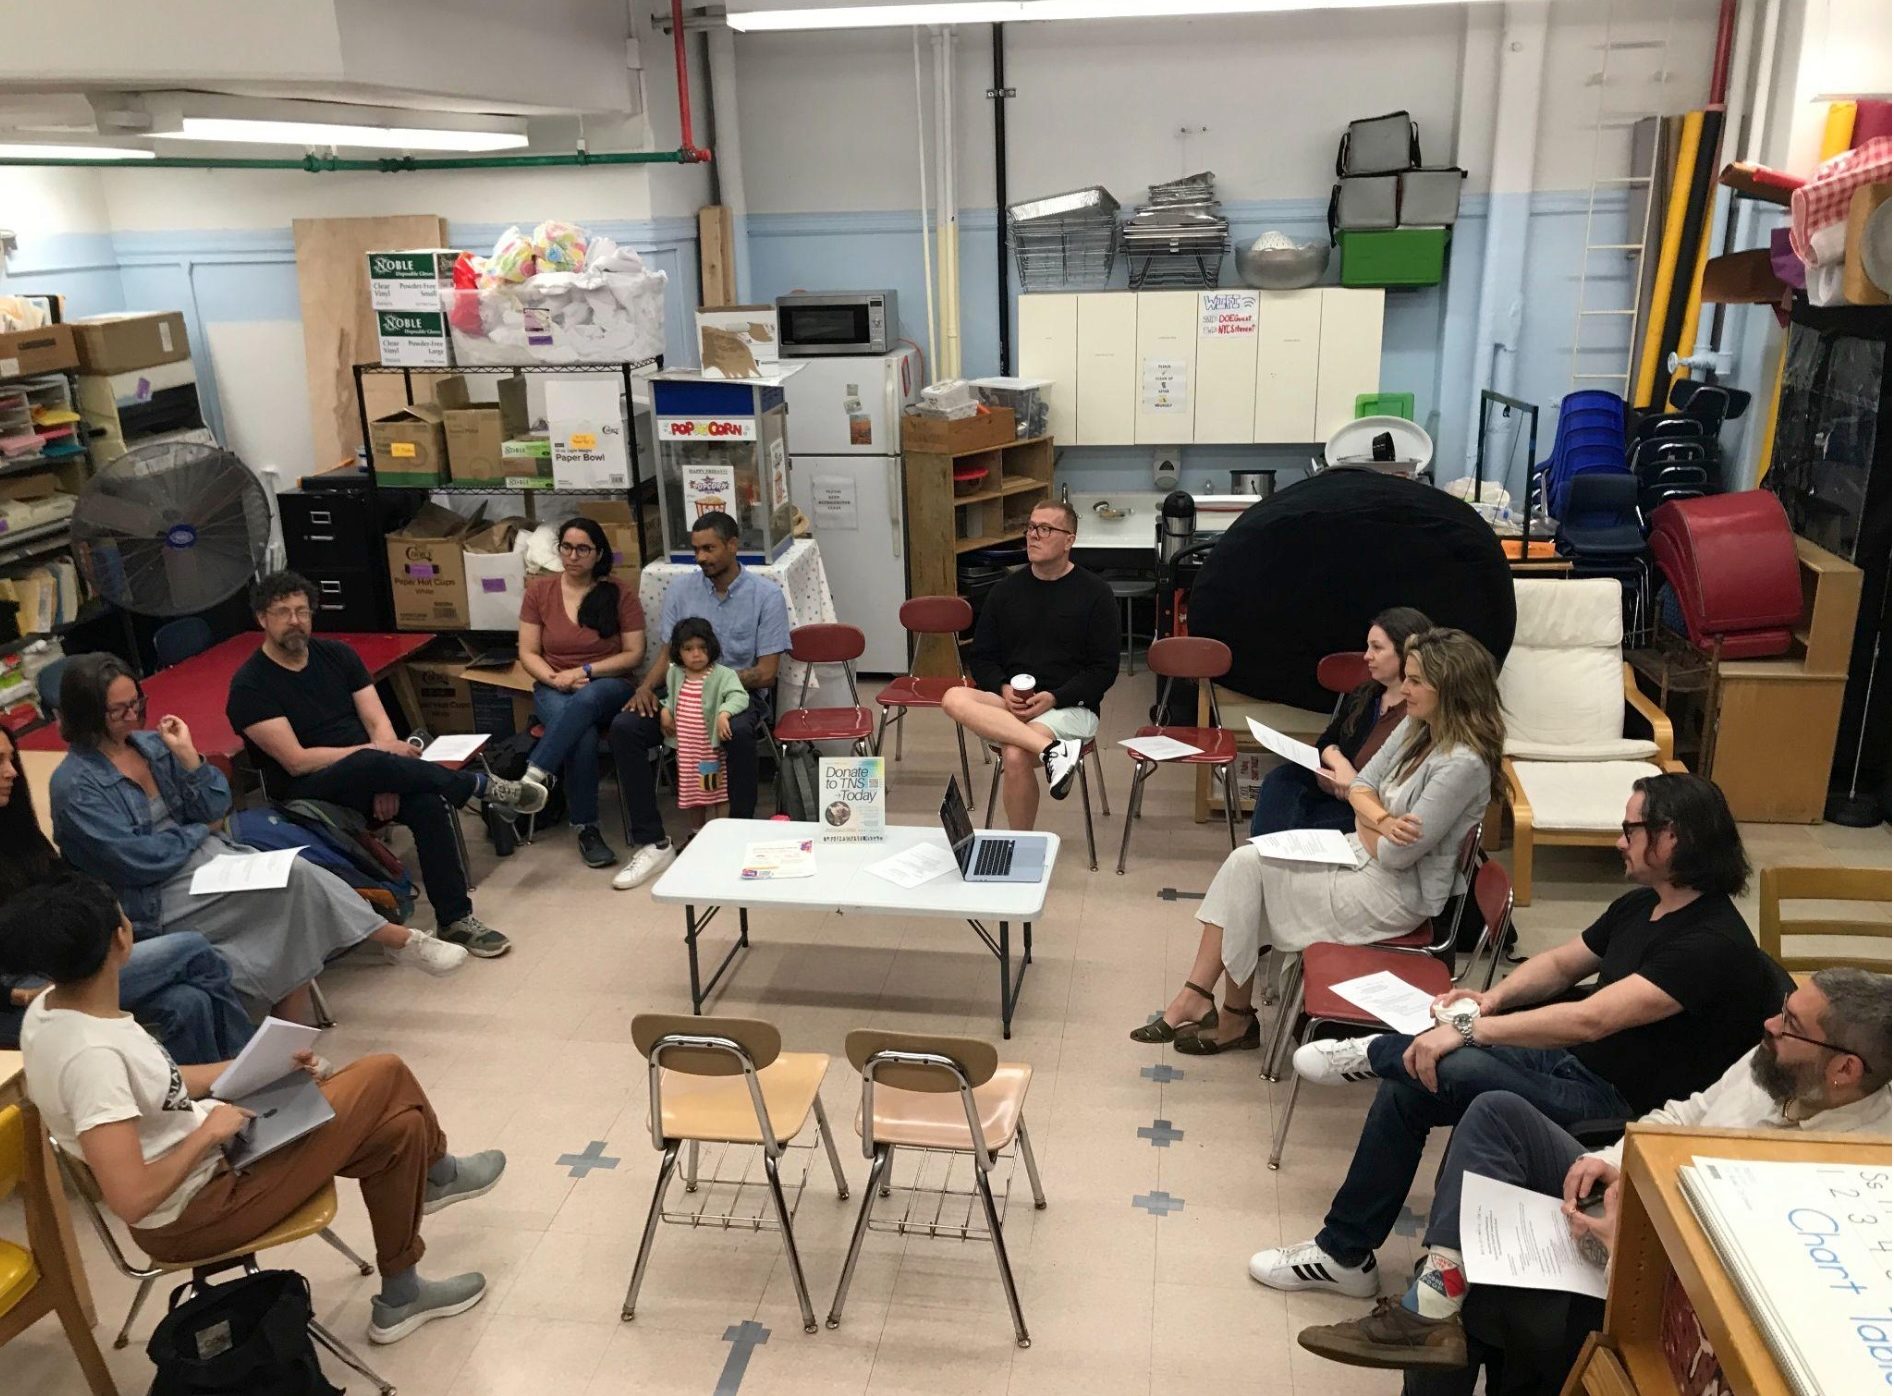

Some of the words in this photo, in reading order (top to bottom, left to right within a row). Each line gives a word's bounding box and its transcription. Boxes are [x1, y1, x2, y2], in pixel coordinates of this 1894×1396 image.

[373, 256, 414, 273] NOBLE
[383, 314, 423, 330] NOBLE
[555, 453, 581, 463] Paper
[583, 453, 606, 462] Bowl
[826, 766, 869, 778] Donate
[826, 779, 838, 789] to
[840, 777, 865, 789] TNS
[841, 789, 878, 804] Today
[1787, 1207, 1868, 1295] Chart
